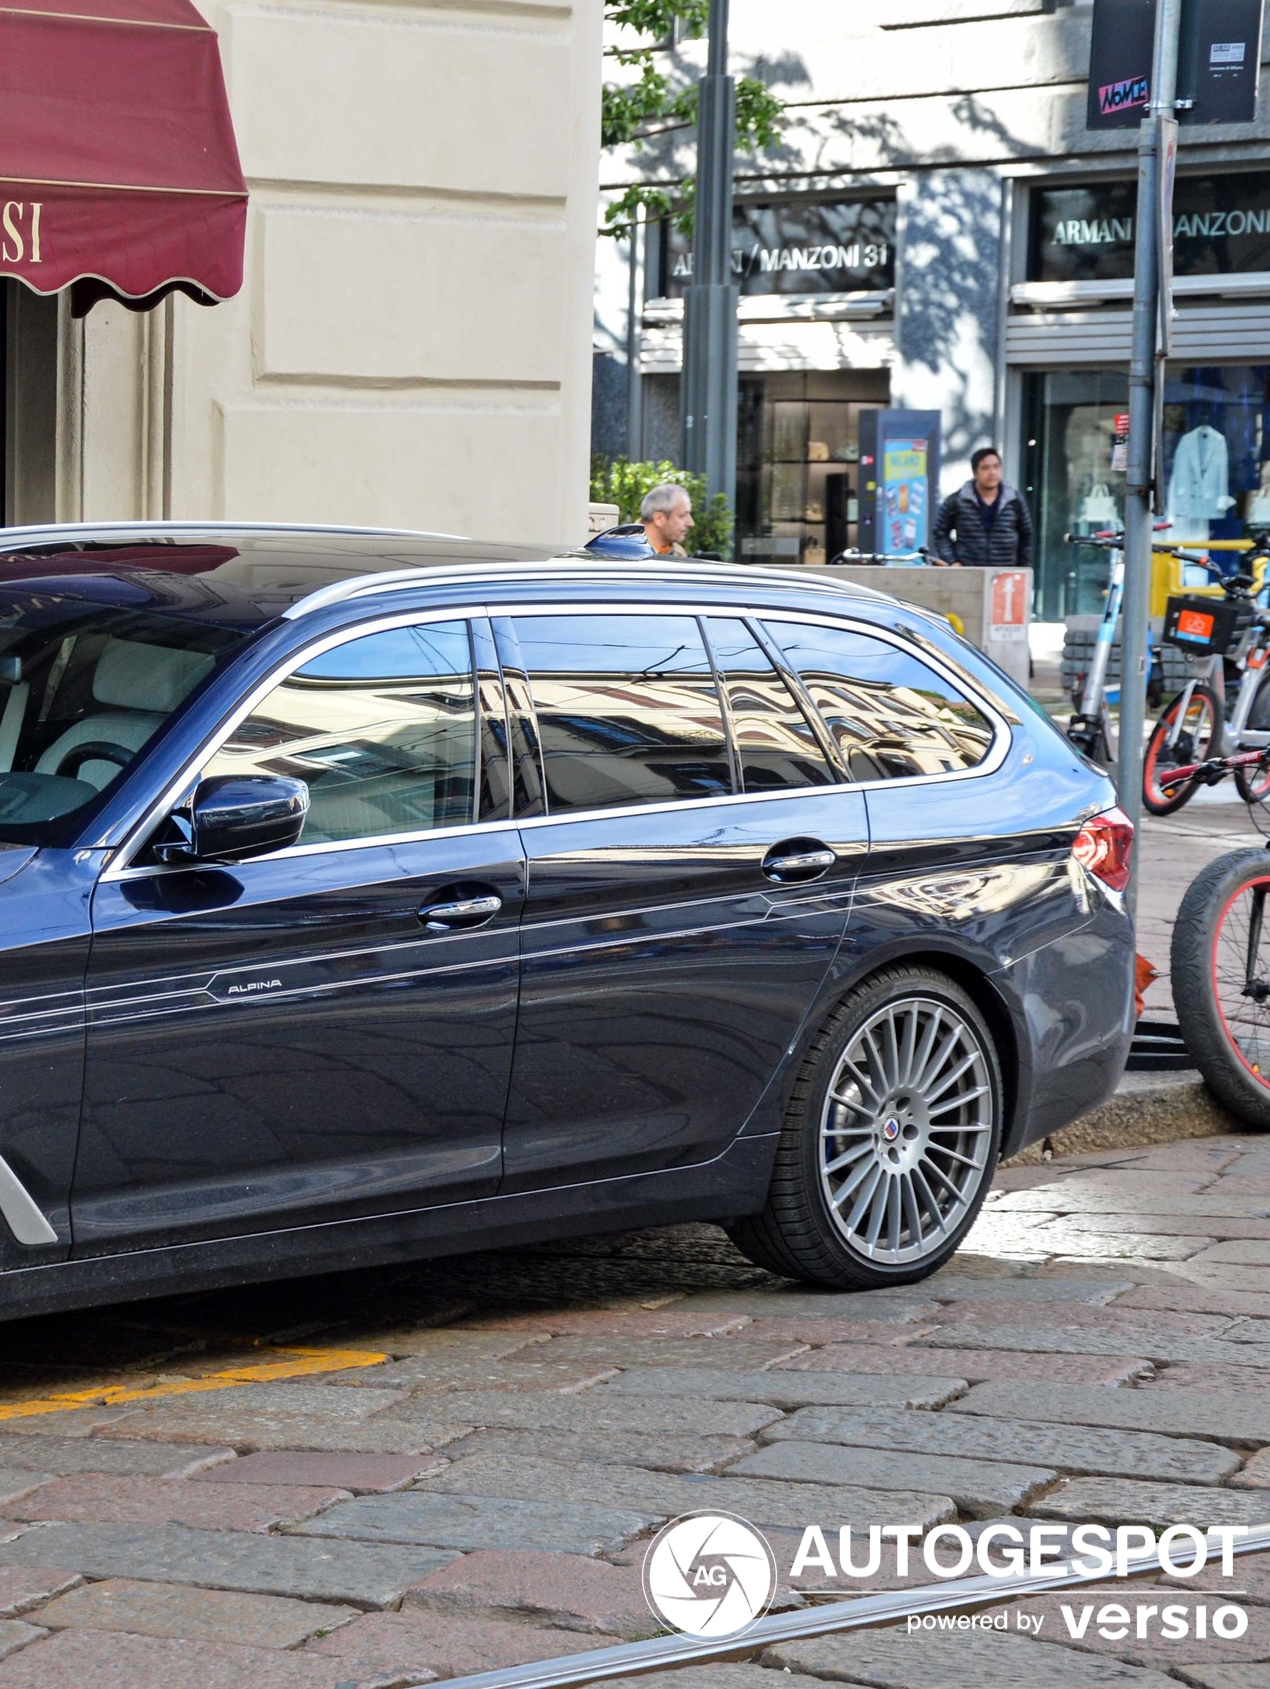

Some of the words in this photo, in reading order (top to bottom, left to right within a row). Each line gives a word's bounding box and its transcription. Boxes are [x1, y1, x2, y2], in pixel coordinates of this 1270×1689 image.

[1050, 216, 1133, 246] ARMANI
[1172, 208, 1270, 238] ANZONI
[760, 244, 859, 272] MANZONI
[227, 979, 283, 995] ALPINA
